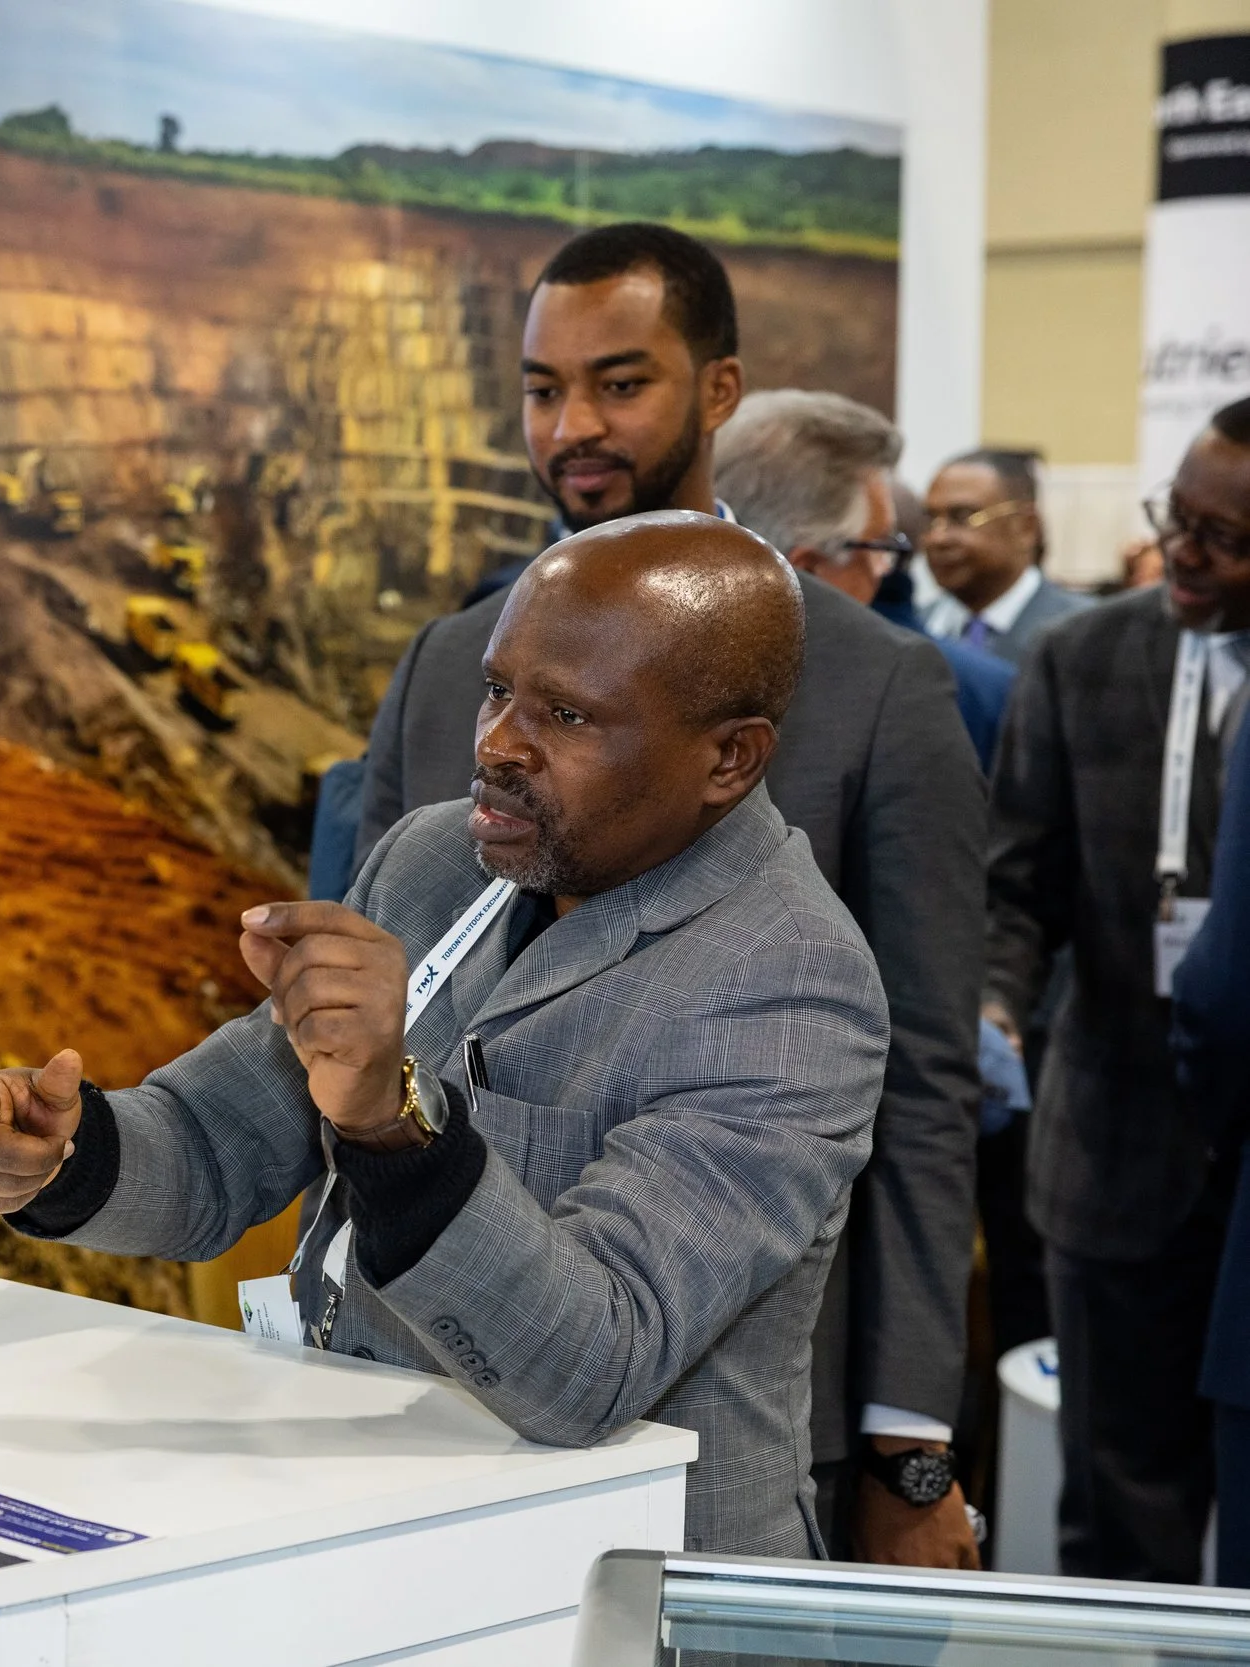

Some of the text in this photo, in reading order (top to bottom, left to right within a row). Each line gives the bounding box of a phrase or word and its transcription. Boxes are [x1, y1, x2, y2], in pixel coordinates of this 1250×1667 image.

[415, 963, 439, 997] TMX
[441, 931, 467, 961] TORONTO
[465, 910, 485, 933] STOCK
